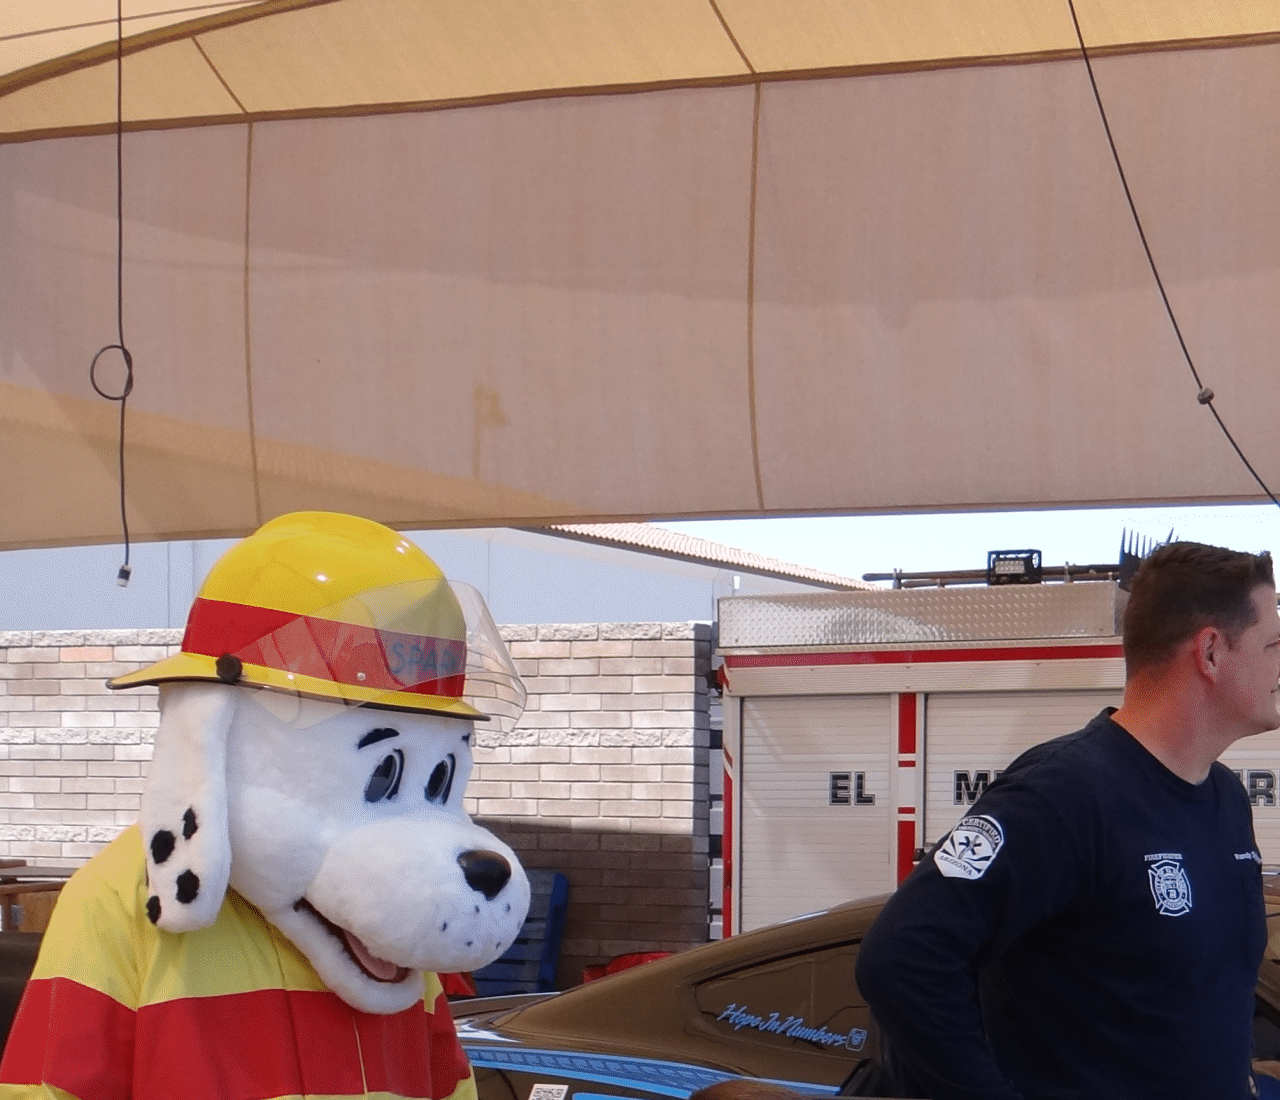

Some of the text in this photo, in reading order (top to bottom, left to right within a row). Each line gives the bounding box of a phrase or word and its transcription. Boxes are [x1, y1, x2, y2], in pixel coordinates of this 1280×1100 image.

[829, 771, 875, 806] EL
[961, 818, 1001, 844] CERTIFIED
[938, 855, 973, 876] ARIZONA
